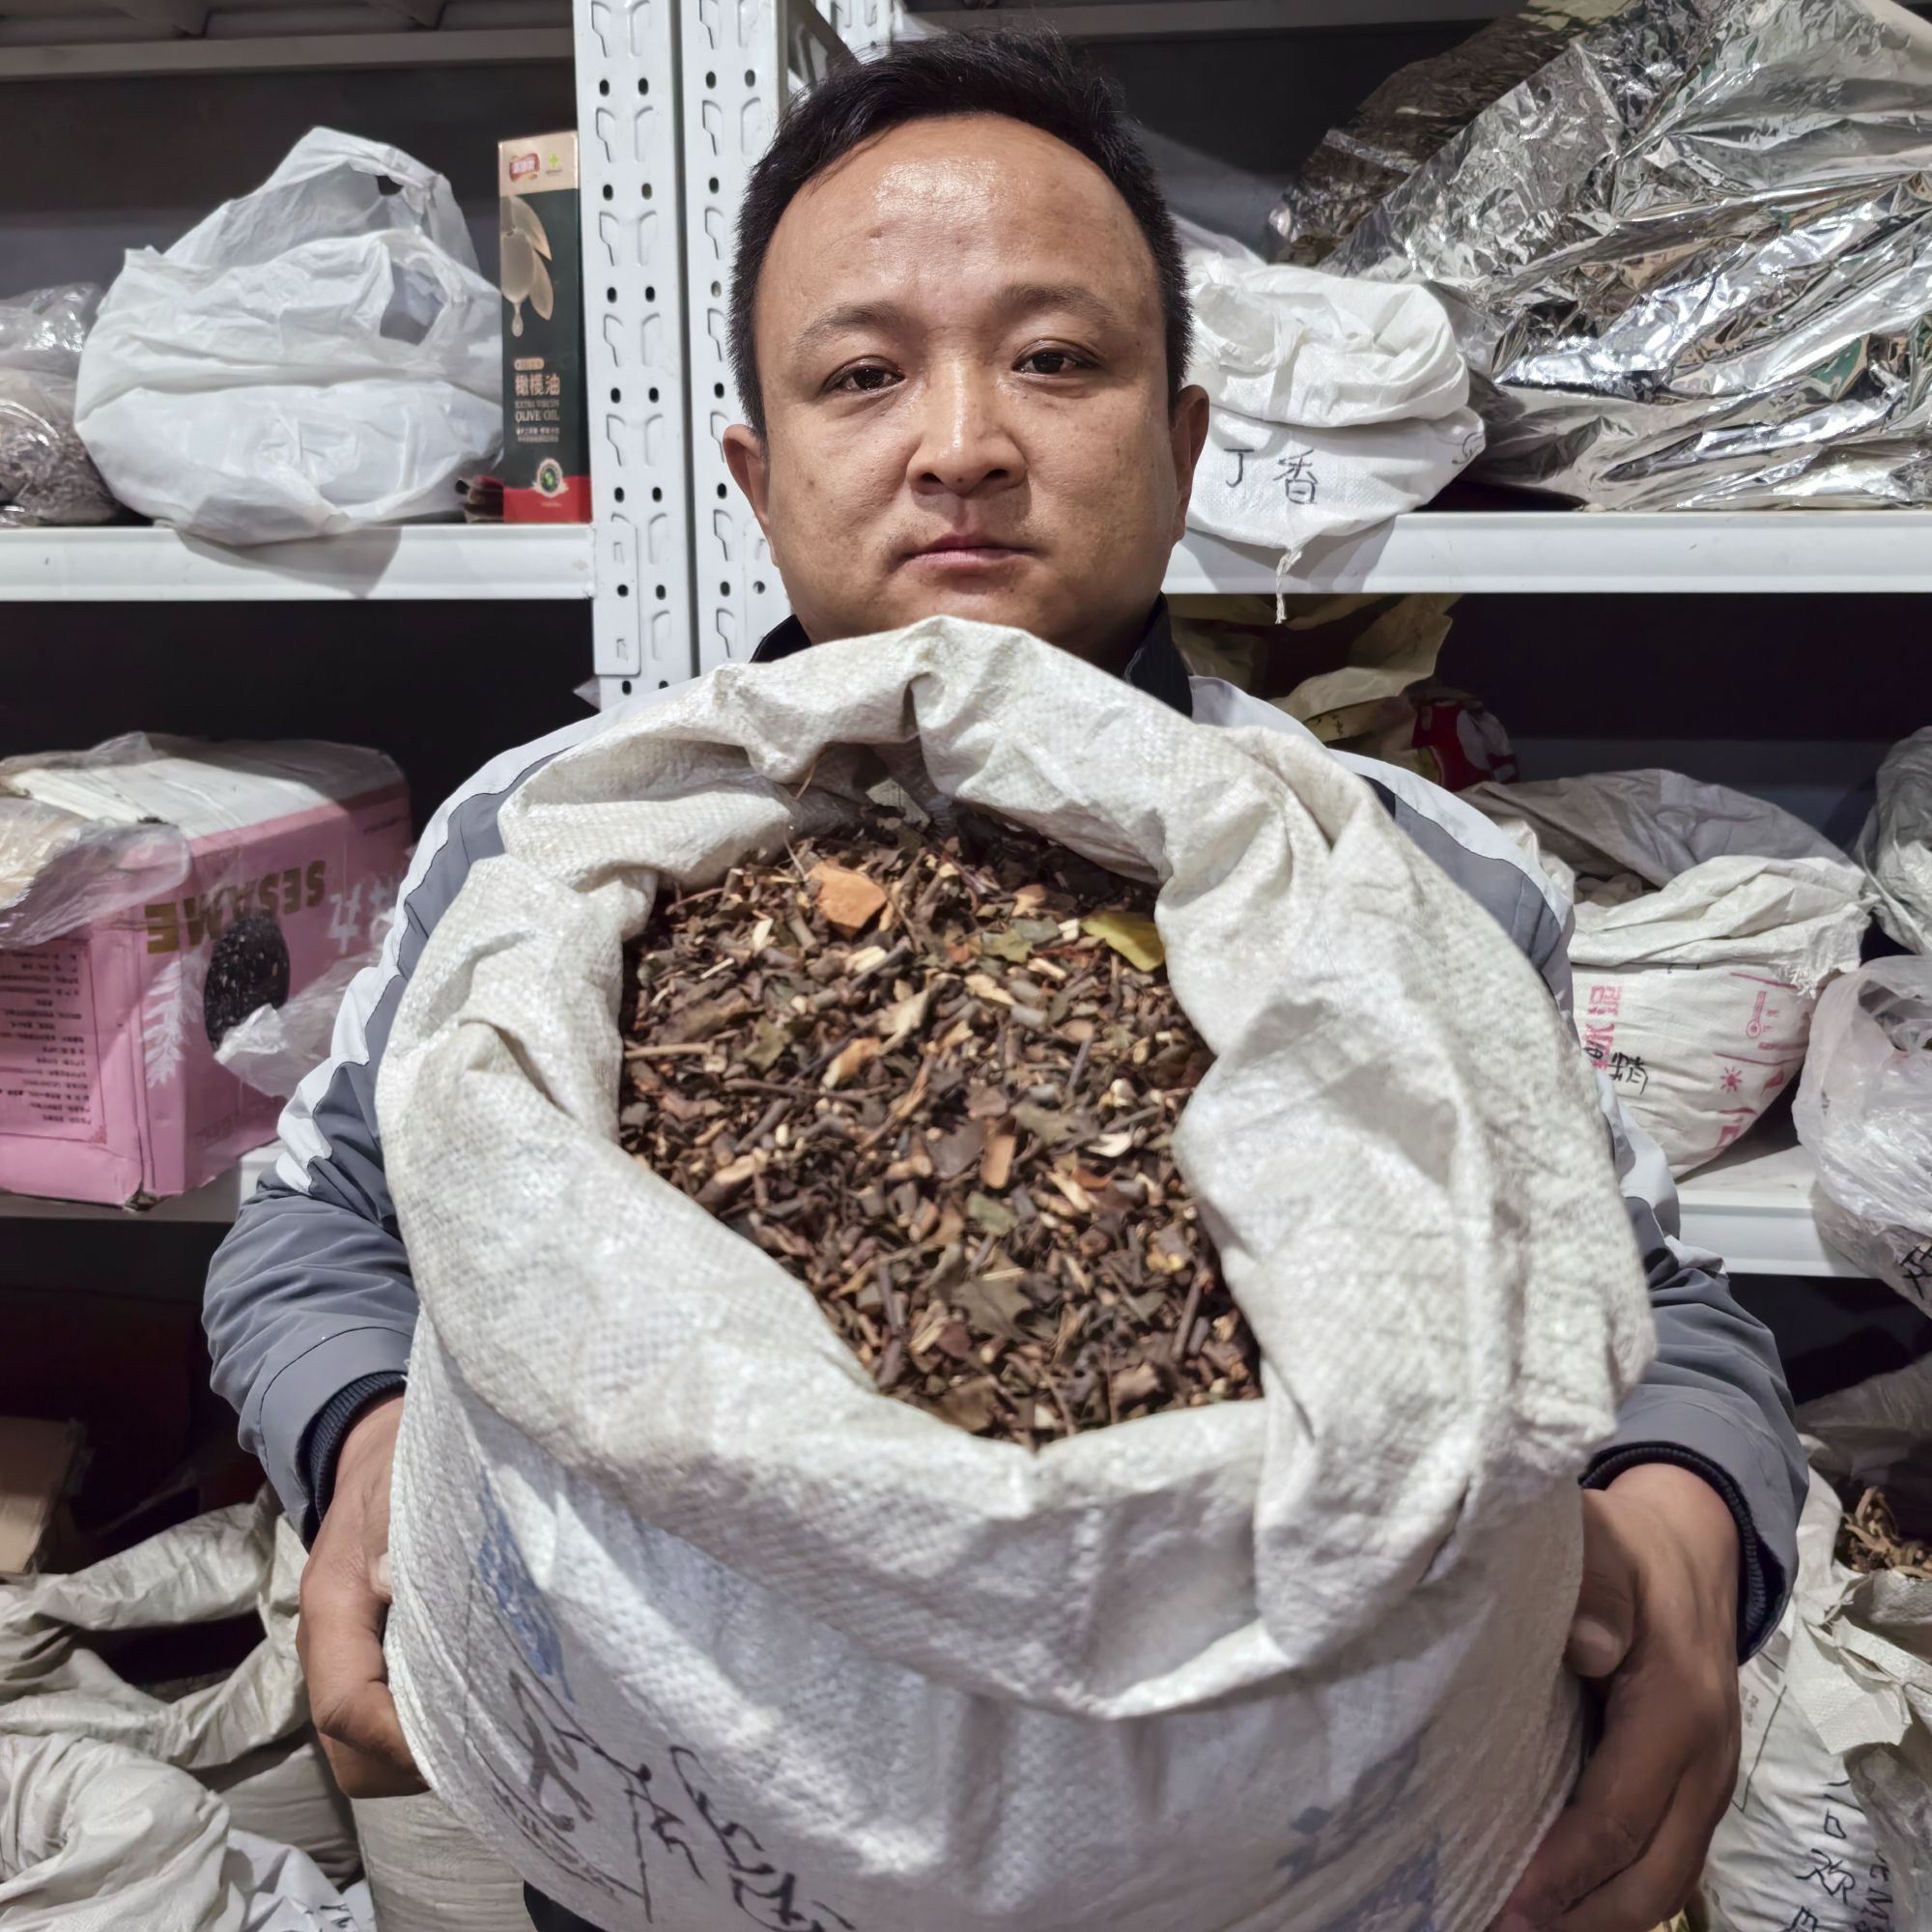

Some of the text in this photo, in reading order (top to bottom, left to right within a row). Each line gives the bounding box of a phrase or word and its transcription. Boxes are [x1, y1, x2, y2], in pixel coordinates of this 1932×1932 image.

[515, 373, 560, 396] 橄榄油
[515, 409, 560, 423] OLIVE OIL
[1224, 448, 1319, 504] 丁香
[145, 860, 327, 954] SESAME
